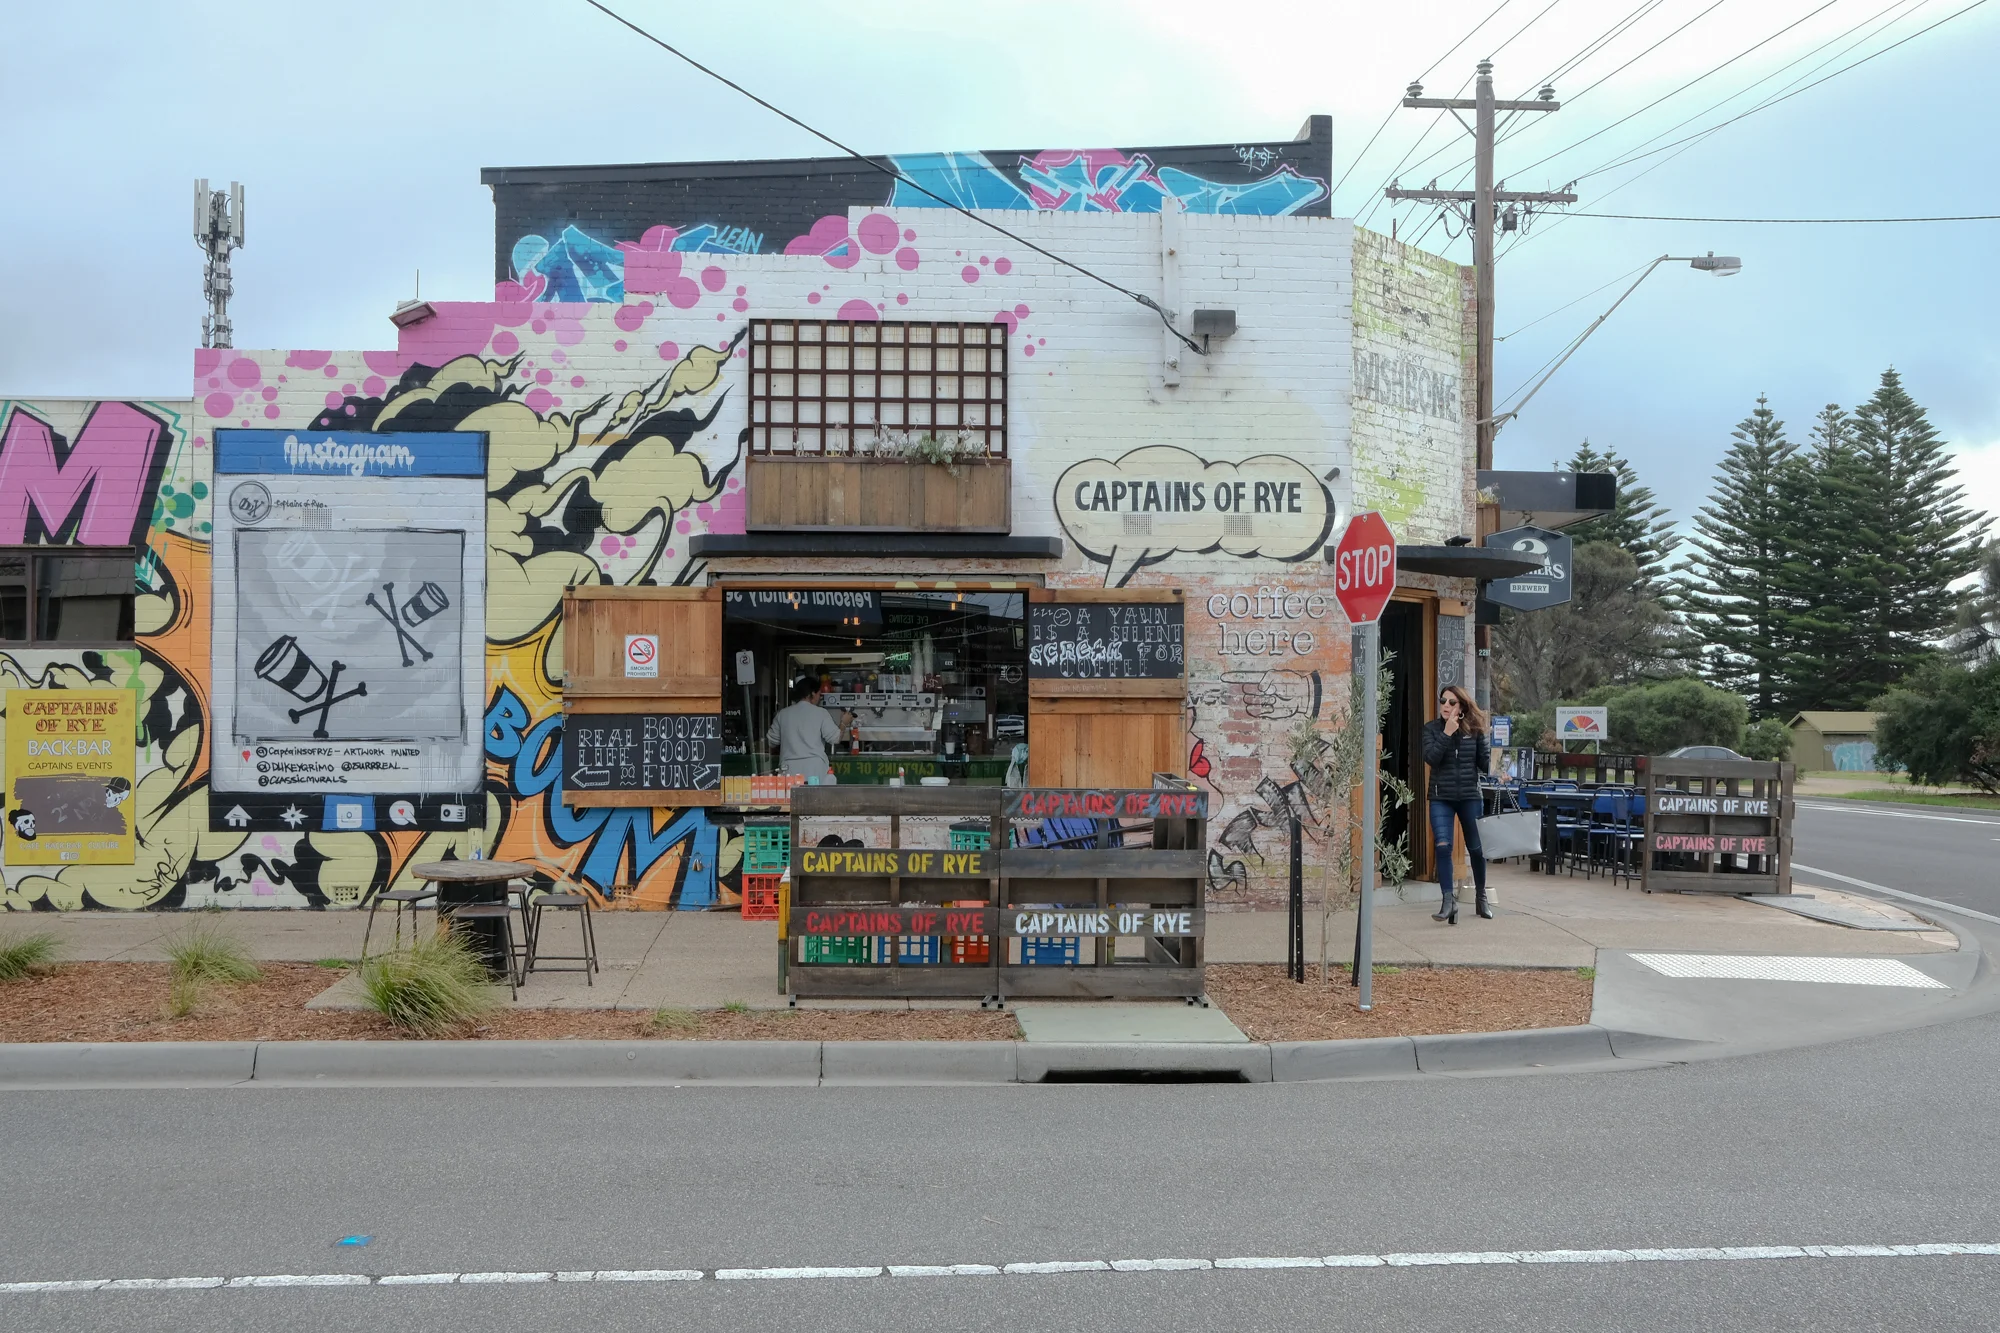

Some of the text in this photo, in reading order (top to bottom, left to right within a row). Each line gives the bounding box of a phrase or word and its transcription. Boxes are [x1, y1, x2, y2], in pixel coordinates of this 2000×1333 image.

[716, 225, 763, 254] LEAN
[284, 434, 416, 477] Instagram
[1074, 481, 1302, 513] CAPTAINS OF RYE
[1338, 545, 1391, 591] STOP
[1207, 585, 1328, 619] coffee
[1076, 608, 1091, 624] A
[1108, 607, 1168, 624] YAWN
[1077, 626, 1090, 641] A
[1218, 622, 1315, 656] here
[1029, 638, 1184, 666] SCREAM FOR
[1060, 658, 1152, 678] COFFEE
[23, 702, 118, 716] CAPTAINS
[36, 718, 106, 732] OF RYE
[643, 716, 721, 740] BOOZE
[28, 740, 112, 756] BACK-BAR
[578, 728, 638, 748] REAL
[343, 748, 385, 756] ARTWORK
[391, 748, 420, 757] PAINTED
[579, 747, 635, 767] LIFE
[643, 740, 706, 763] FOOD
[28, 762, 113, 770] CAPTAINS EVENTS
[643, 765, 689, 788] FUN
[1021, 792, 1197, 816] CAPTAINS OF RYE
[1658, 797, 1768, 815] CAPTAINS OF RYE
[88, 841, 119, 849] CULTURE
[1656, 836, 1766, 852] CAPTAINS OF RYE
[803, 852, 981, 875] CAPTAINS OF RYE
[806, 911, 984, 934] CAPTAINS OF RYE
[1015, 912, 1191, 935] CAPTAINS OF RYE
